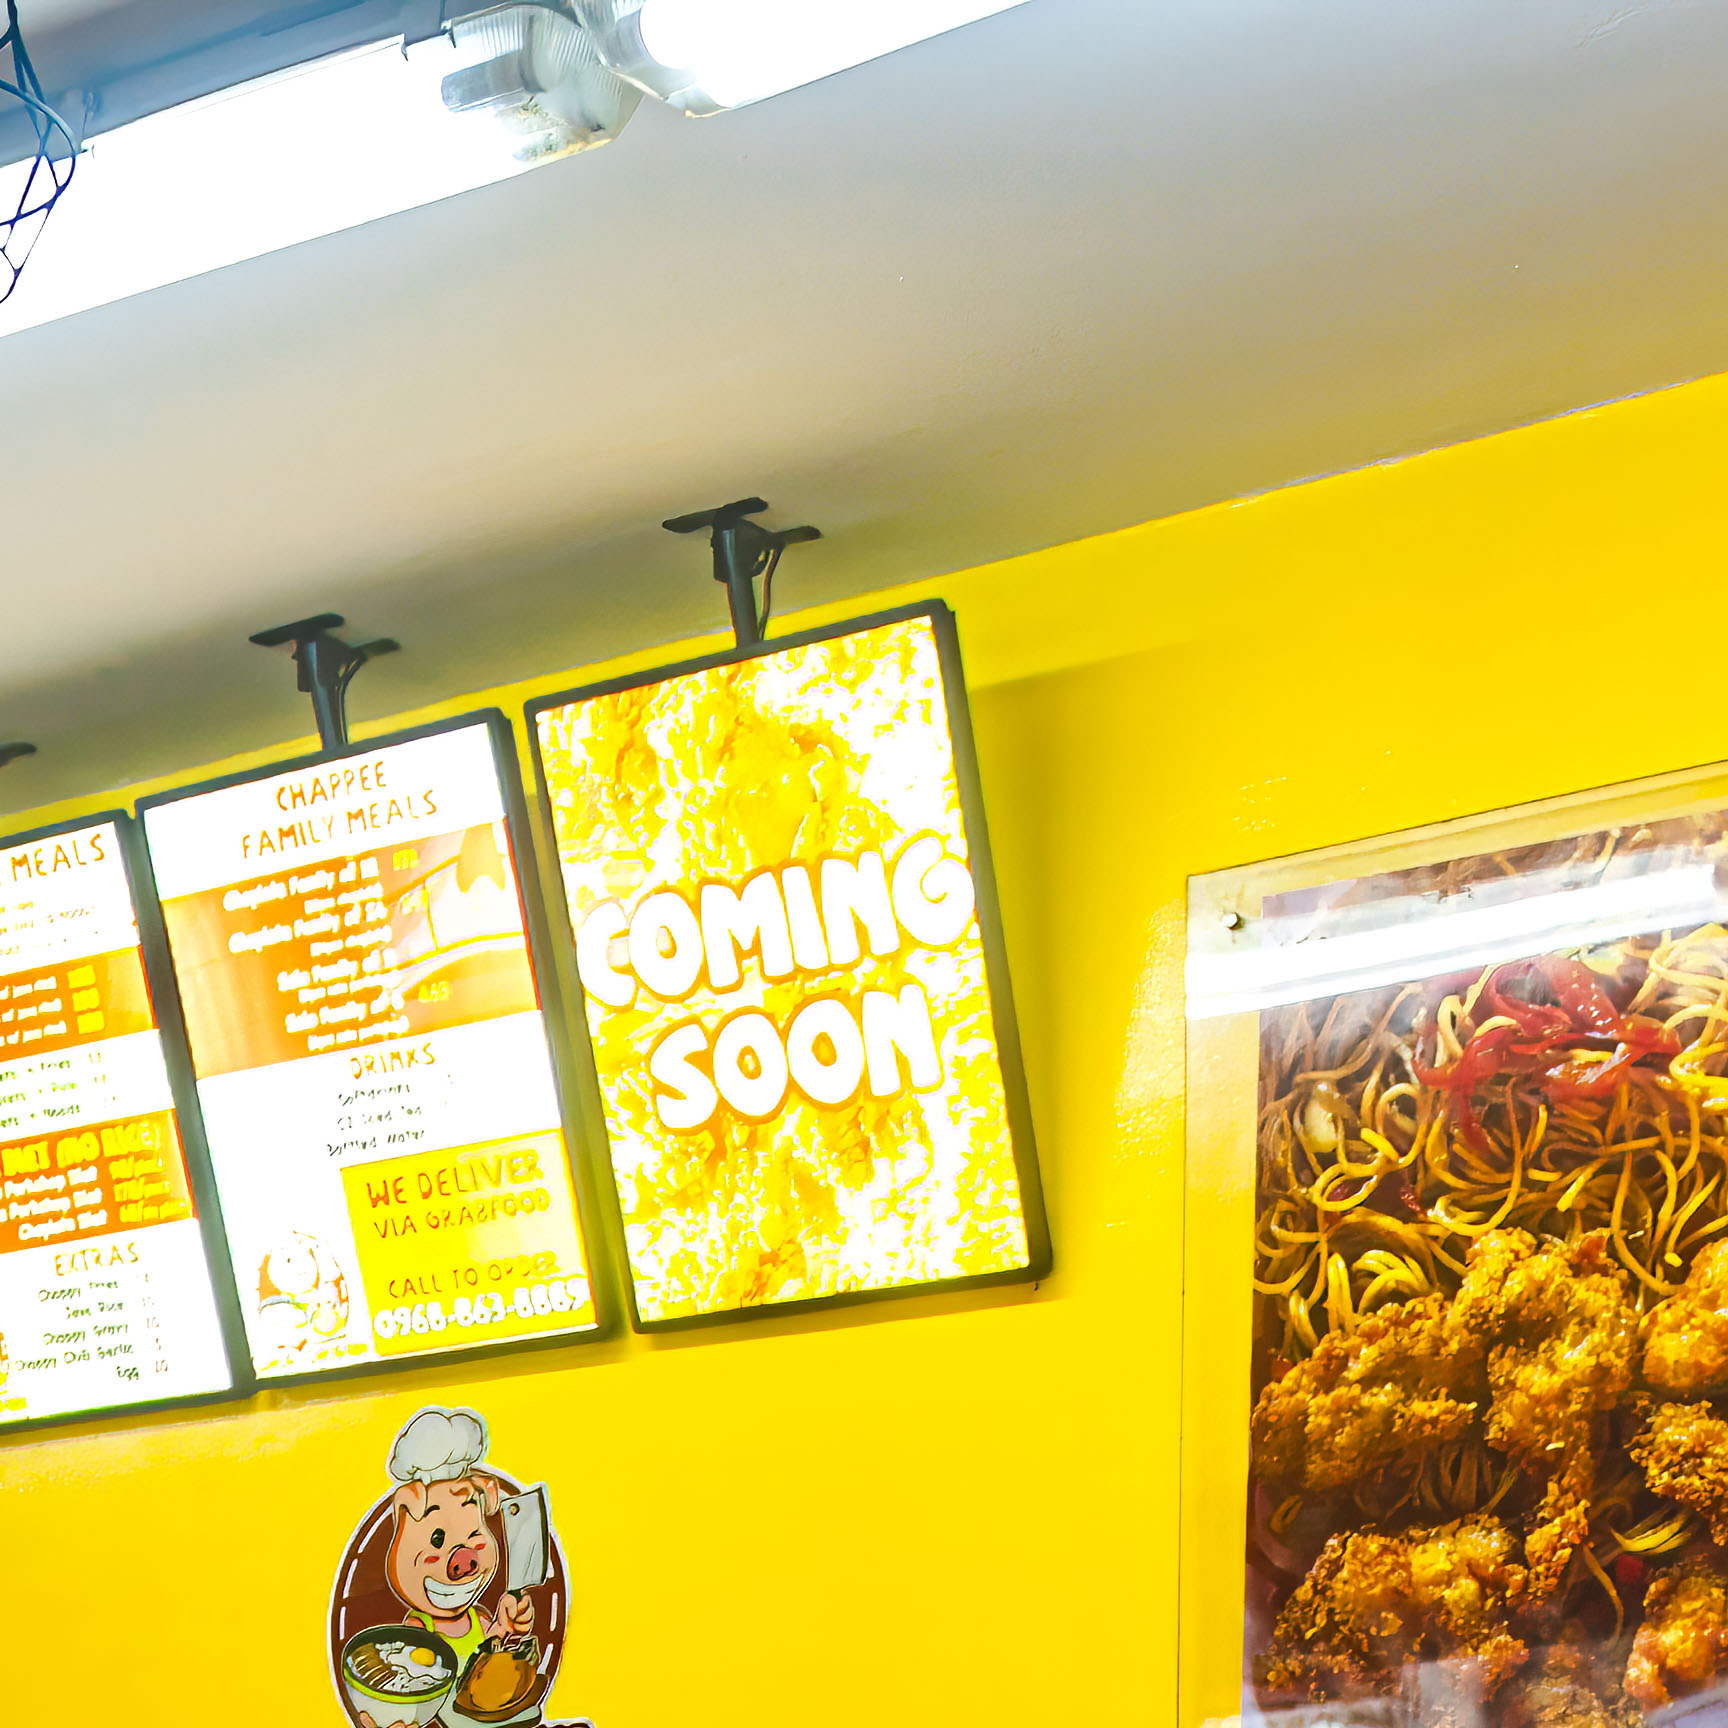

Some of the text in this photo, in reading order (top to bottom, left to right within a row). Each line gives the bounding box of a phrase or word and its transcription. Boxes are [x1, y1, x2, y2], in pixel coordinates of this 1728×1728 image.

[276, 761, 387, 811] CHAPPEE
[242, 790, 437, 858] FAMILY MEALS
[11, 833, 105, 881] MEALS
[577, 836, 976, 1006] COMING
[651, 984, 942, 1130] SOON
[367, 1149, 545, 1208] WE DELIVER
[374, 1215, 417, 1239] VIA
[389, 1273, 442, 1299] CALL
[453, 1267, 478, 1289] TO
